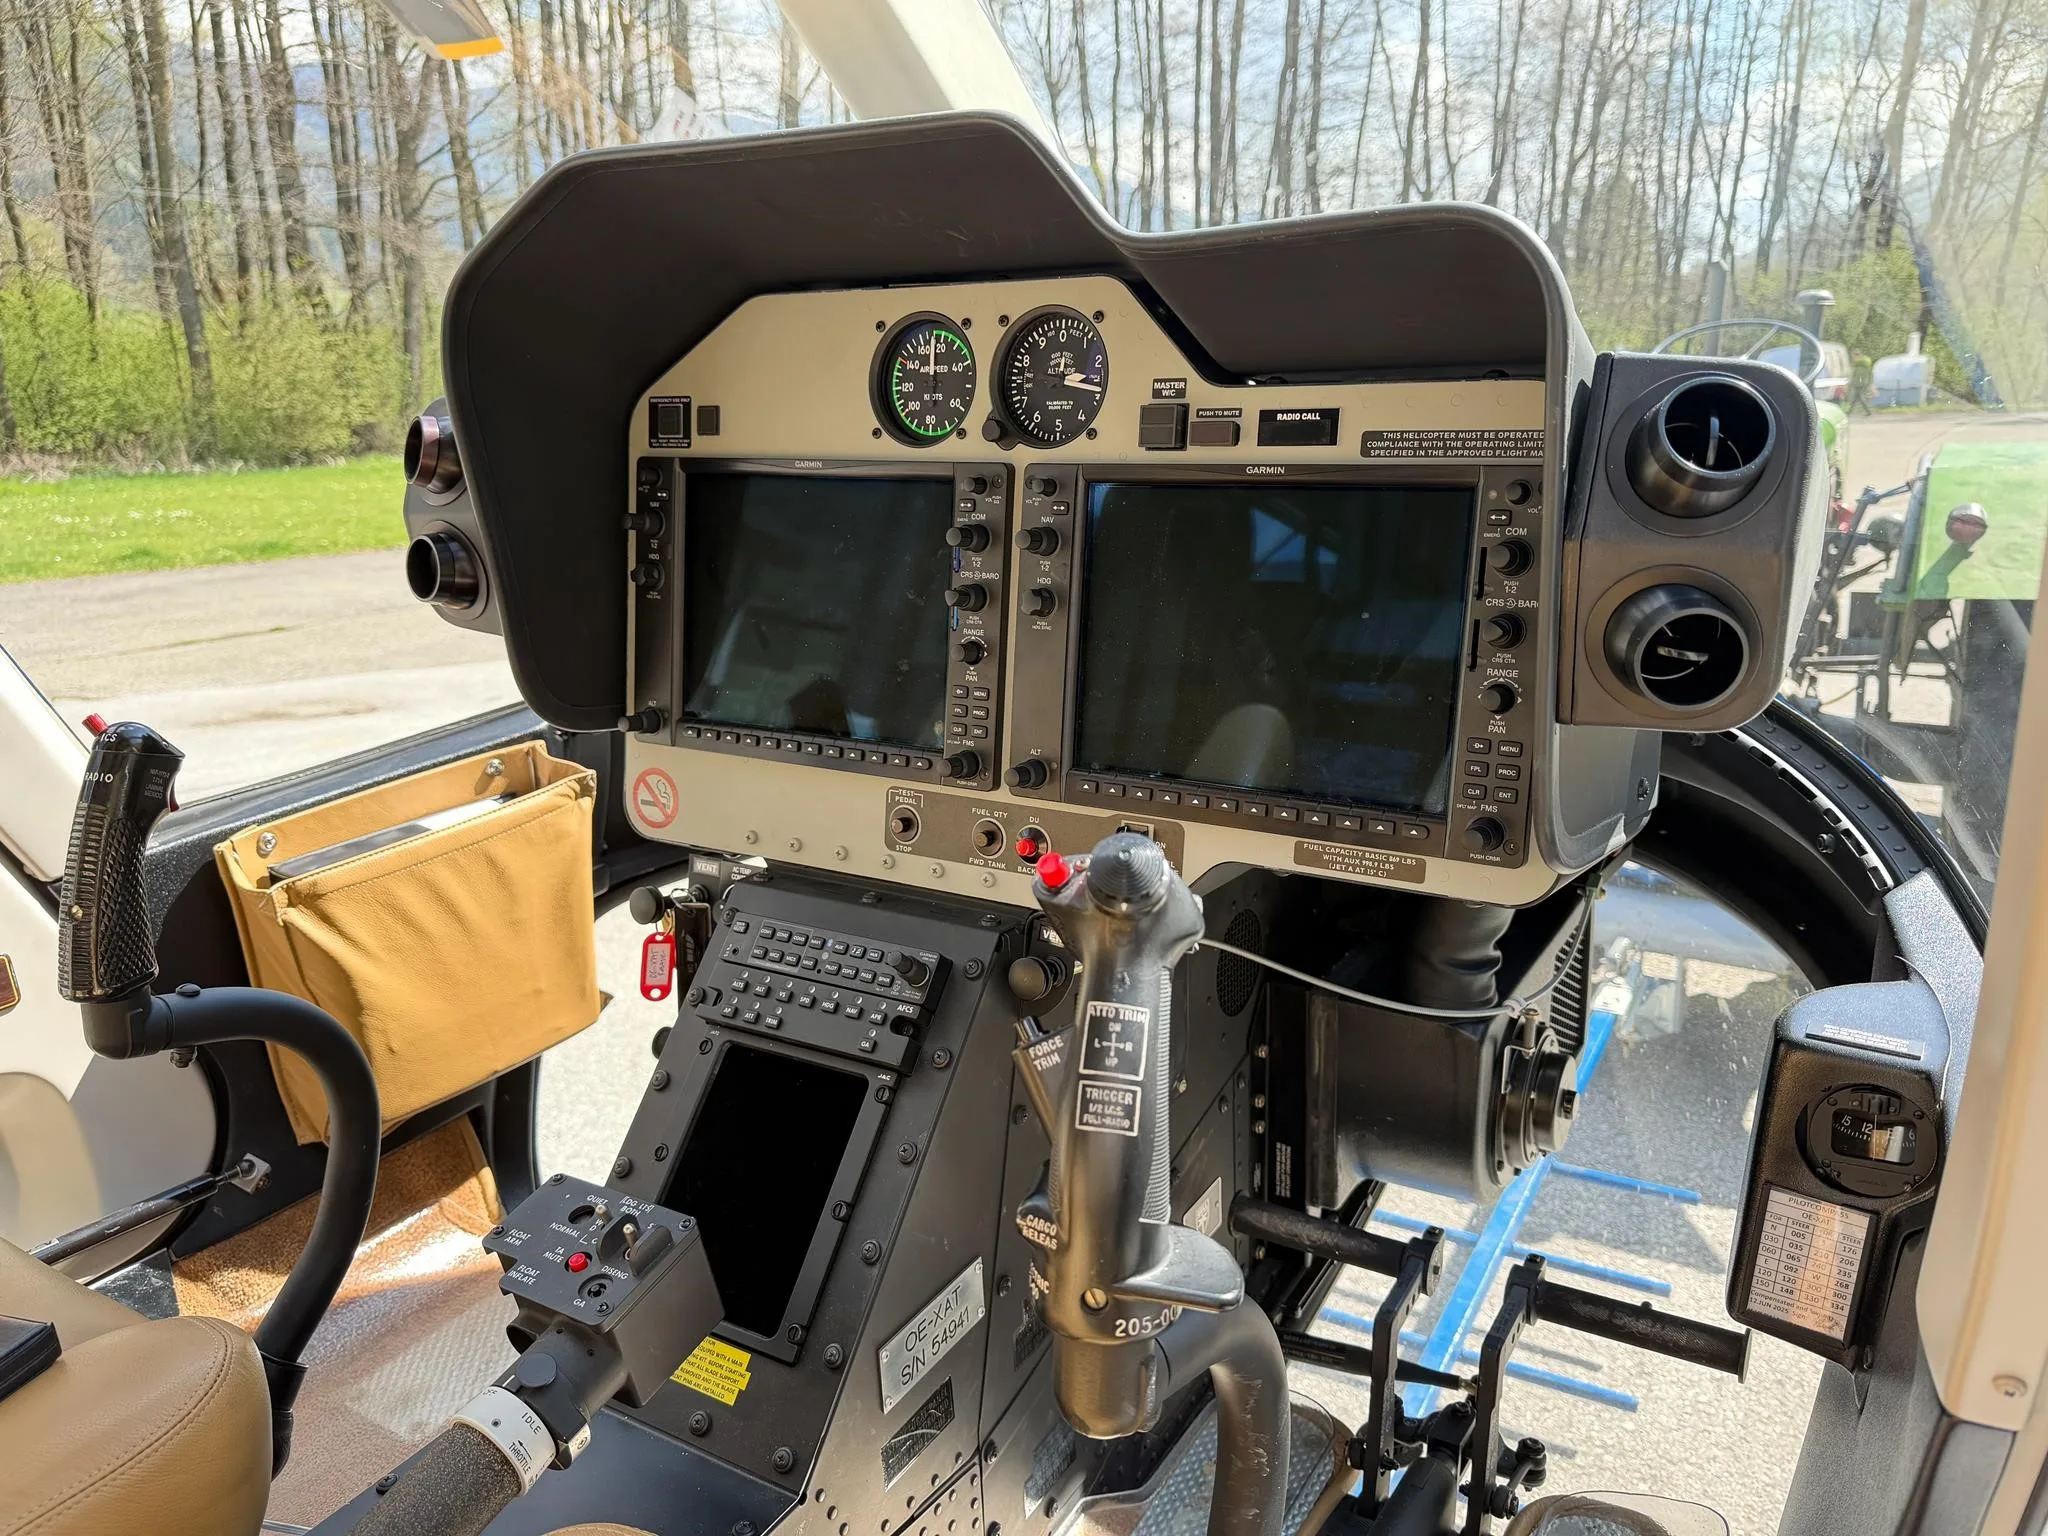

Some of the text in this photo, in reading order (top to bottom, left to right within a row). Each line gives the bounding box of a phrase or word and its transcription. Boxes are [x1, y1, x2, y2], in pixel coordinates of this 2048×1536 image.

[1060, 330, 1066, 342] 0
[1070, 330, 1083, 338] FEET
[936, 344, 945, 352] 20
[1039, 337, 1046, 349] 9
[1084, 337, 1087, 348] 1
[918, 346, 930, 354] 160
[907, 361, 919, 369] 140
[1023, 355, 1029, 366] 8
[1095, 355, 1102, 367] 2
[952, 363, 962, 372] 40
[902, 383, 913, 391] 120
[909, 402, 920, 410] 100
[950, 399, 960, 407] 60
[1022, 397, 1027, 408] 7
[926, 415, 935, 424] 80
[1034, 411, 1040, 422] 6
[1078, 410, 1085, 421] 4
[1056, 420, 1062, 431] 5
[794, 460, 823, 468] GARMIN
[1246, 466, 1285, 474] GARMIN
[1518, 600, 1538, 608] BAR
[1487, 669, 1518, 677] RANGE
[101, 733, 118, 742] ICS
[85, 772, 113, 782] RADIO
[1499, 769, 1516, 777] PROC
[896, 796, 917, 804] PEDAL
[972, 808, 991, 816] FUEL
[1326, 847, 1362, 857] CAPACITY
[1365, 853, 1387, 861] BASIC
[697, 862, 716, 872] VENT
[988, 861, 1006, 869] TANK
[1344, 857, 1360, 865] AUX
[1380, 862, 1394, 870] LBS
[897, 1005, 913, 1013] AFCS
[1090, 1005, 1146, 1023] ATTD TRIM
[1029, 1036, 1064, 1058] FORCE
[1095, 1038, 1100, 1048] L
[1033, 1055, 1061, 1071] TRIM
[1086, 1088, 1133, 1104] TRIGGER
[1842, 1114, 1915, 1140] 15 12 6
[587, 1195, 608, 1204] QUIET
[621, 1206, 641, 1217] BOTH
[1802, 1213, 1830, 1225] OE-XAT
[550, 1222, 580, 1238] NORMAL
[1027, 1215, 1057, 1236] CARGO
[509, 1228, 531, 1240] FLOAT
[1792, 1221, 1861, 1245] STEER STEER
[504, 1236, 523, 1247] ARM
[1791, 1231, 1806, 1239] 005
[1843, 1247, 1857, 1255] 176
[1764, 1235, 1778, 1243] 030
[1789, 1242, 1803, 1251] 035
[1840, 1257, 1855, 1266] 206
[543, 1251, 564, 1263] MUTE
[1762, 1246, 1851, 1278] 060 065 235
[517, 1264, 540, 1277] FLOAT
[602, 1265, 629, 1280] DISENG
[508, 1270, 536, 1285] INFLATE
[1784, 1265, 1798, 1273] 092
[1835, 1281, 1849, 1289] 268
[1755, 1279, 1794, 1295] 150 148
[1758, 1268, 1847, 1300] 120 120 300
[574, 1299, 586, 1308] GA
[1751, 1290, 1795, 1308] Compensated
[1773, 1305, 1788, 1313] 2025
[905, 1285, 961, 1352] OE-XAT
[901, 1349, 926, 1386] S/N
[932, 1306, 970, 1356] 54941
[716, 1352, 727, 1360] WITH
[709, 1359, 746, 1379] BEFORE STARTING
[680, 1367, 701, 1379] REMOVED
[702, 1376, 711, 1384] AND
[721, 1384, 735, 1394] BLADE
[705, 1366, 740, 1385] BLADE SUPPORT
[702, 1384, 724, 1399] INSTALLED
[521, 1412, 542, 1435] IDLE
[509, 1442, 532, 1474] THROTTLE
